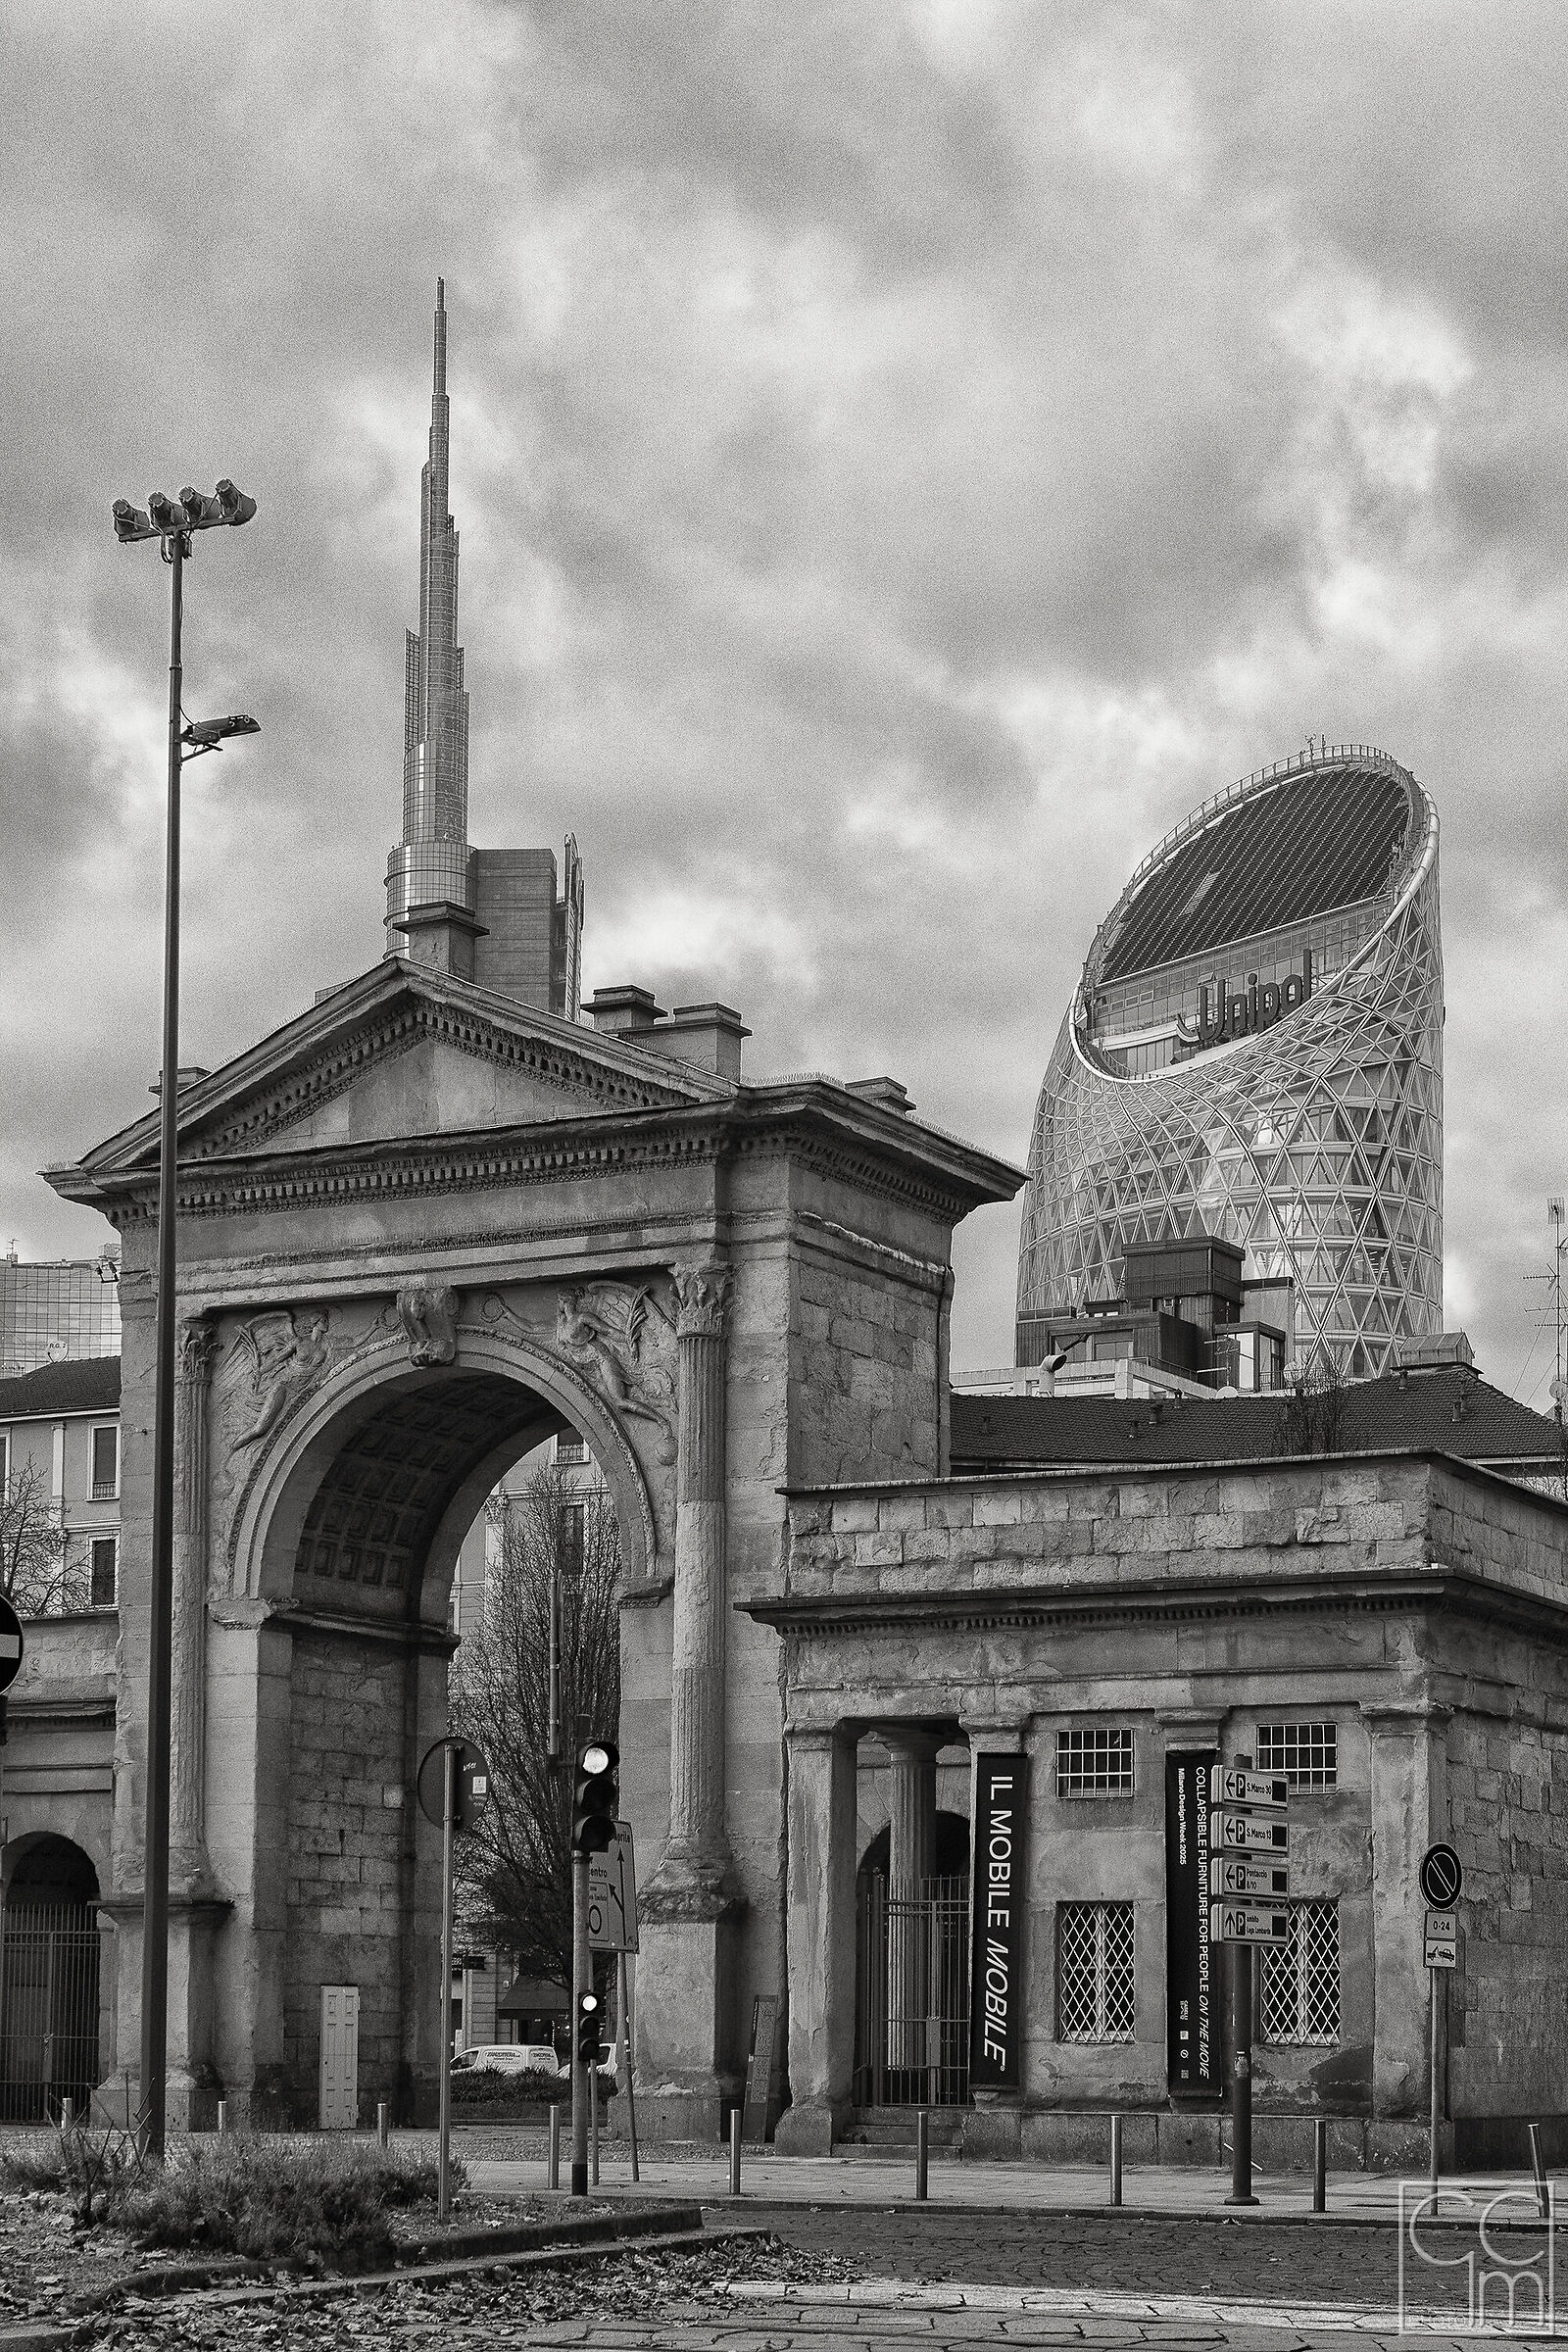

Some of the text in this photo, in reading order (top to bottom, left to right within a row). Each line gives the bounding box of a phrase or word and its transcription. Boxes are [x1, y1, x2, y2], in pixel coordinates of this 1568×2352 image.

[1199, 949, 1311, 1041] Unipol
[990, 1776, 1013, 1800] IL
[1178, 1794, 1187, 1822] Design
[589, 1867, 608, 1878] entro
[987, 1810, 1012, 1928] MOBILE
[1196, 1766, 1209, 2080] COLLAPSIBLE FURNITURE FOR PEOPLE ON THE MOVE
